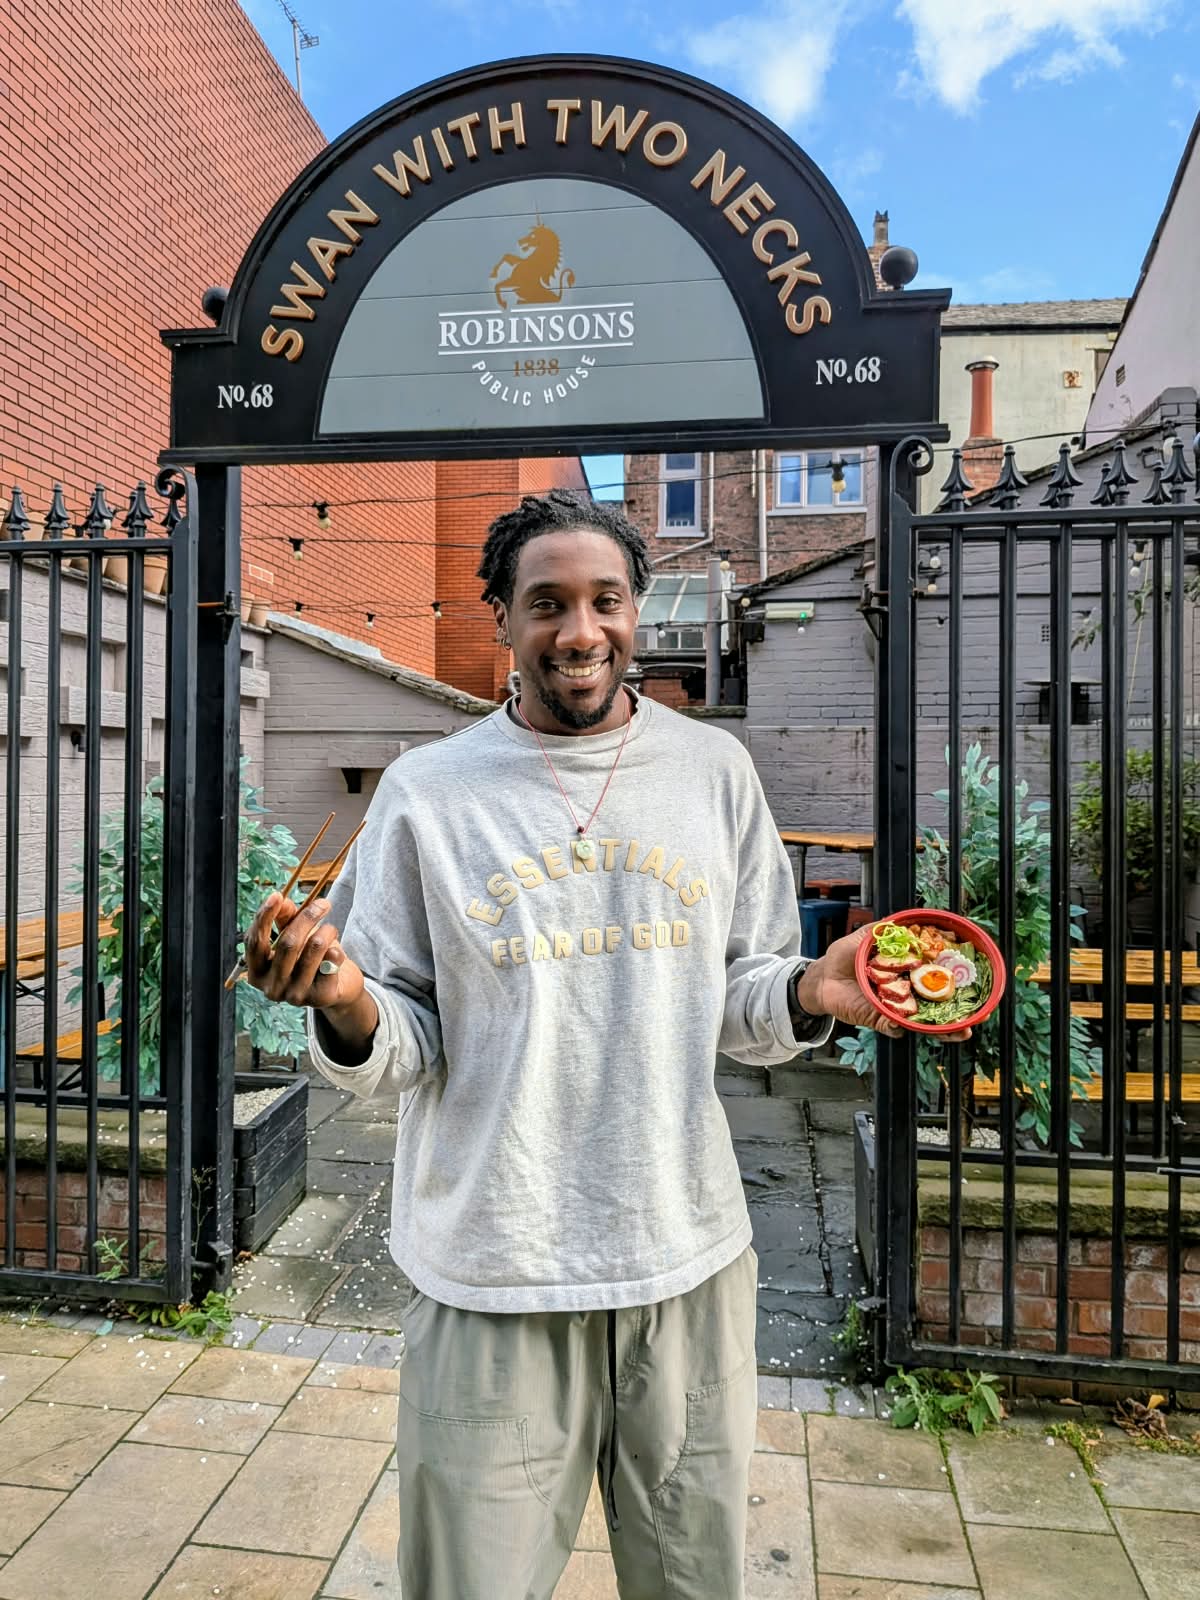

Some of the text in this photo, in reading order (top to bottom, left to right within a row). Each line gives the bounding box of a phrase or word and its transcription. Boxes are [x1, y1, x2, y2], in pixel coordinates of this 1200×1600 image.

[261, 98, 832, 362] SWAN WITH TWO NECKS
[438, 311, 635, 347] ROBINSONS
[472, 354, 596, 406] PUBLIC HOUSE
[513, 358, 560, 377] 1838
[491, 919, 689, 967] FEAR OF GOD
